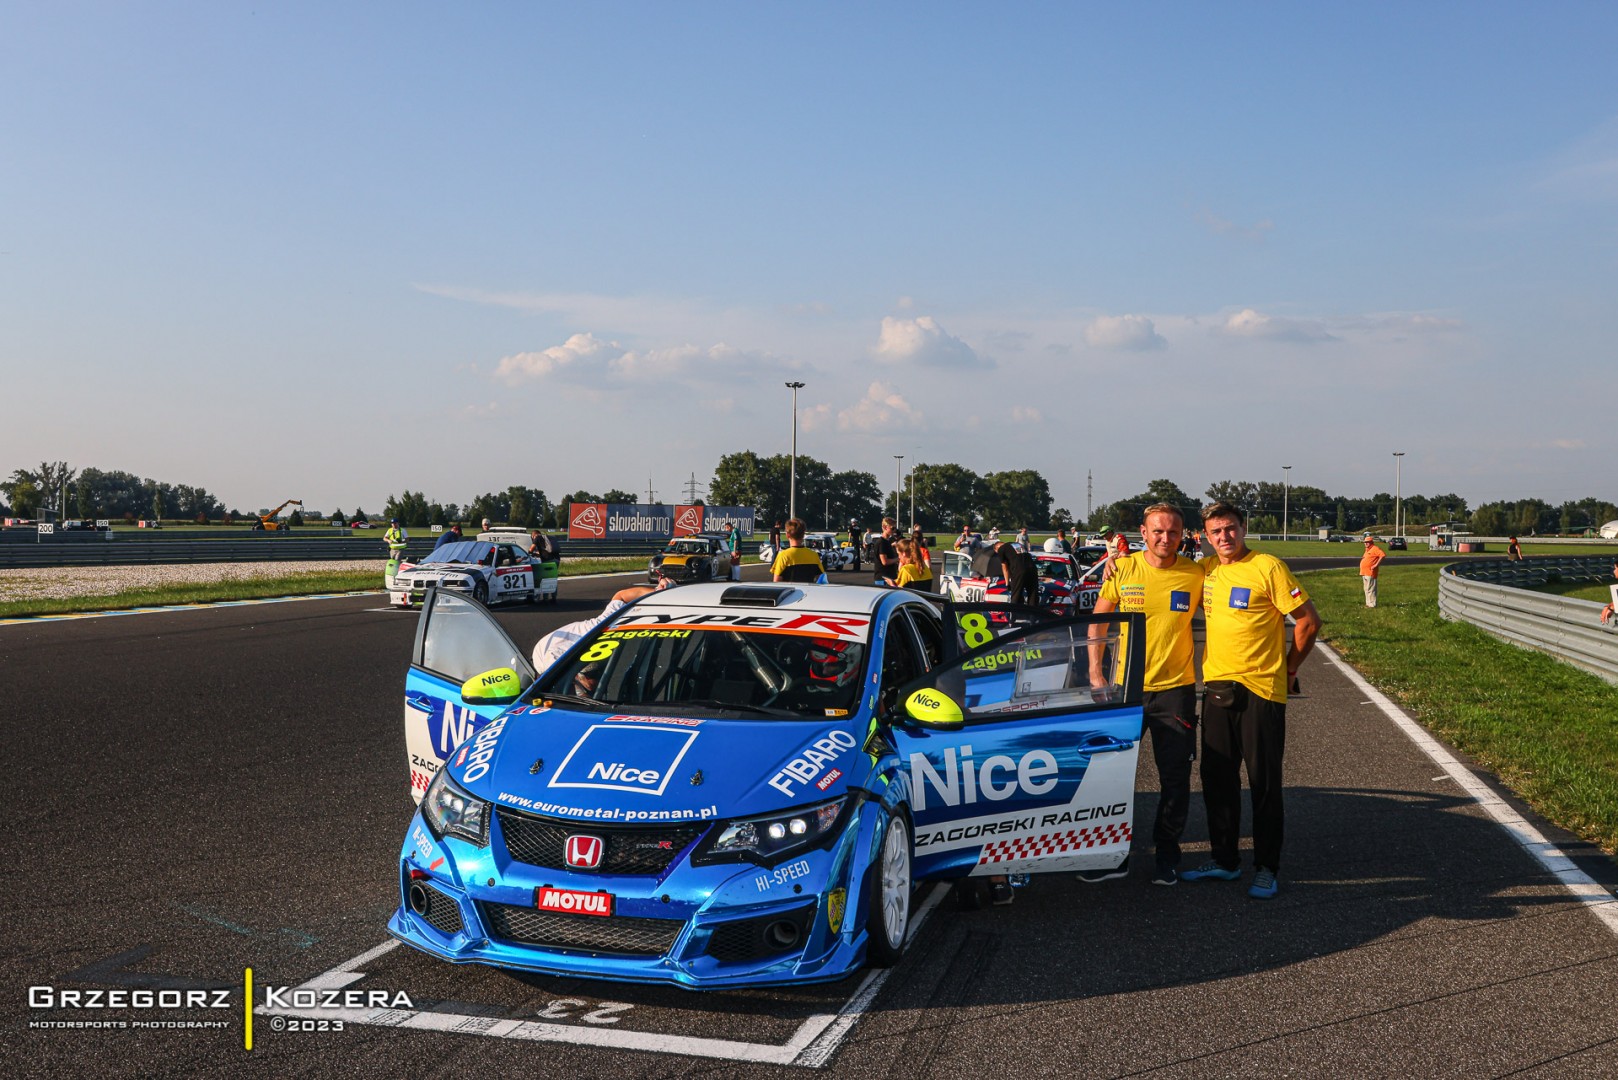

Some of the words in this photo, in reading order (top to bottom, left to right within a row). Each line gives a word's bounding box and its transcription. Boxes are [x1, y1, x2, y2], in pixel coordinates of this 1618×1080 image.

[39, 525, 53, 533] 200
[609, 510, 670, 536] slovakiaring
[503, 574, 527, 590] 321
[960, 613, 994, 649] 8
[579, 640, 620, 663] 8
[481, 672, 511, 687] Nice
[912, 693, 941, 710] Nice
[441, 700, 477, 753] Ni
[463, 716, 509, 784] FIBARO
[587, 762, 660, 785] Nice
[768, 729, 857, 799] FIBARO
[817, 769, 842, 791] MOTUL
[909, 744, 1059, 812] Nice
[497, 791, 718, 821] www.eurometal-poznan.pl
[1041, 803, 1128, 826] RACING
[755, 860, 811, 893] HI-SPEED
[542, 891, 608, 913] MOTUL
